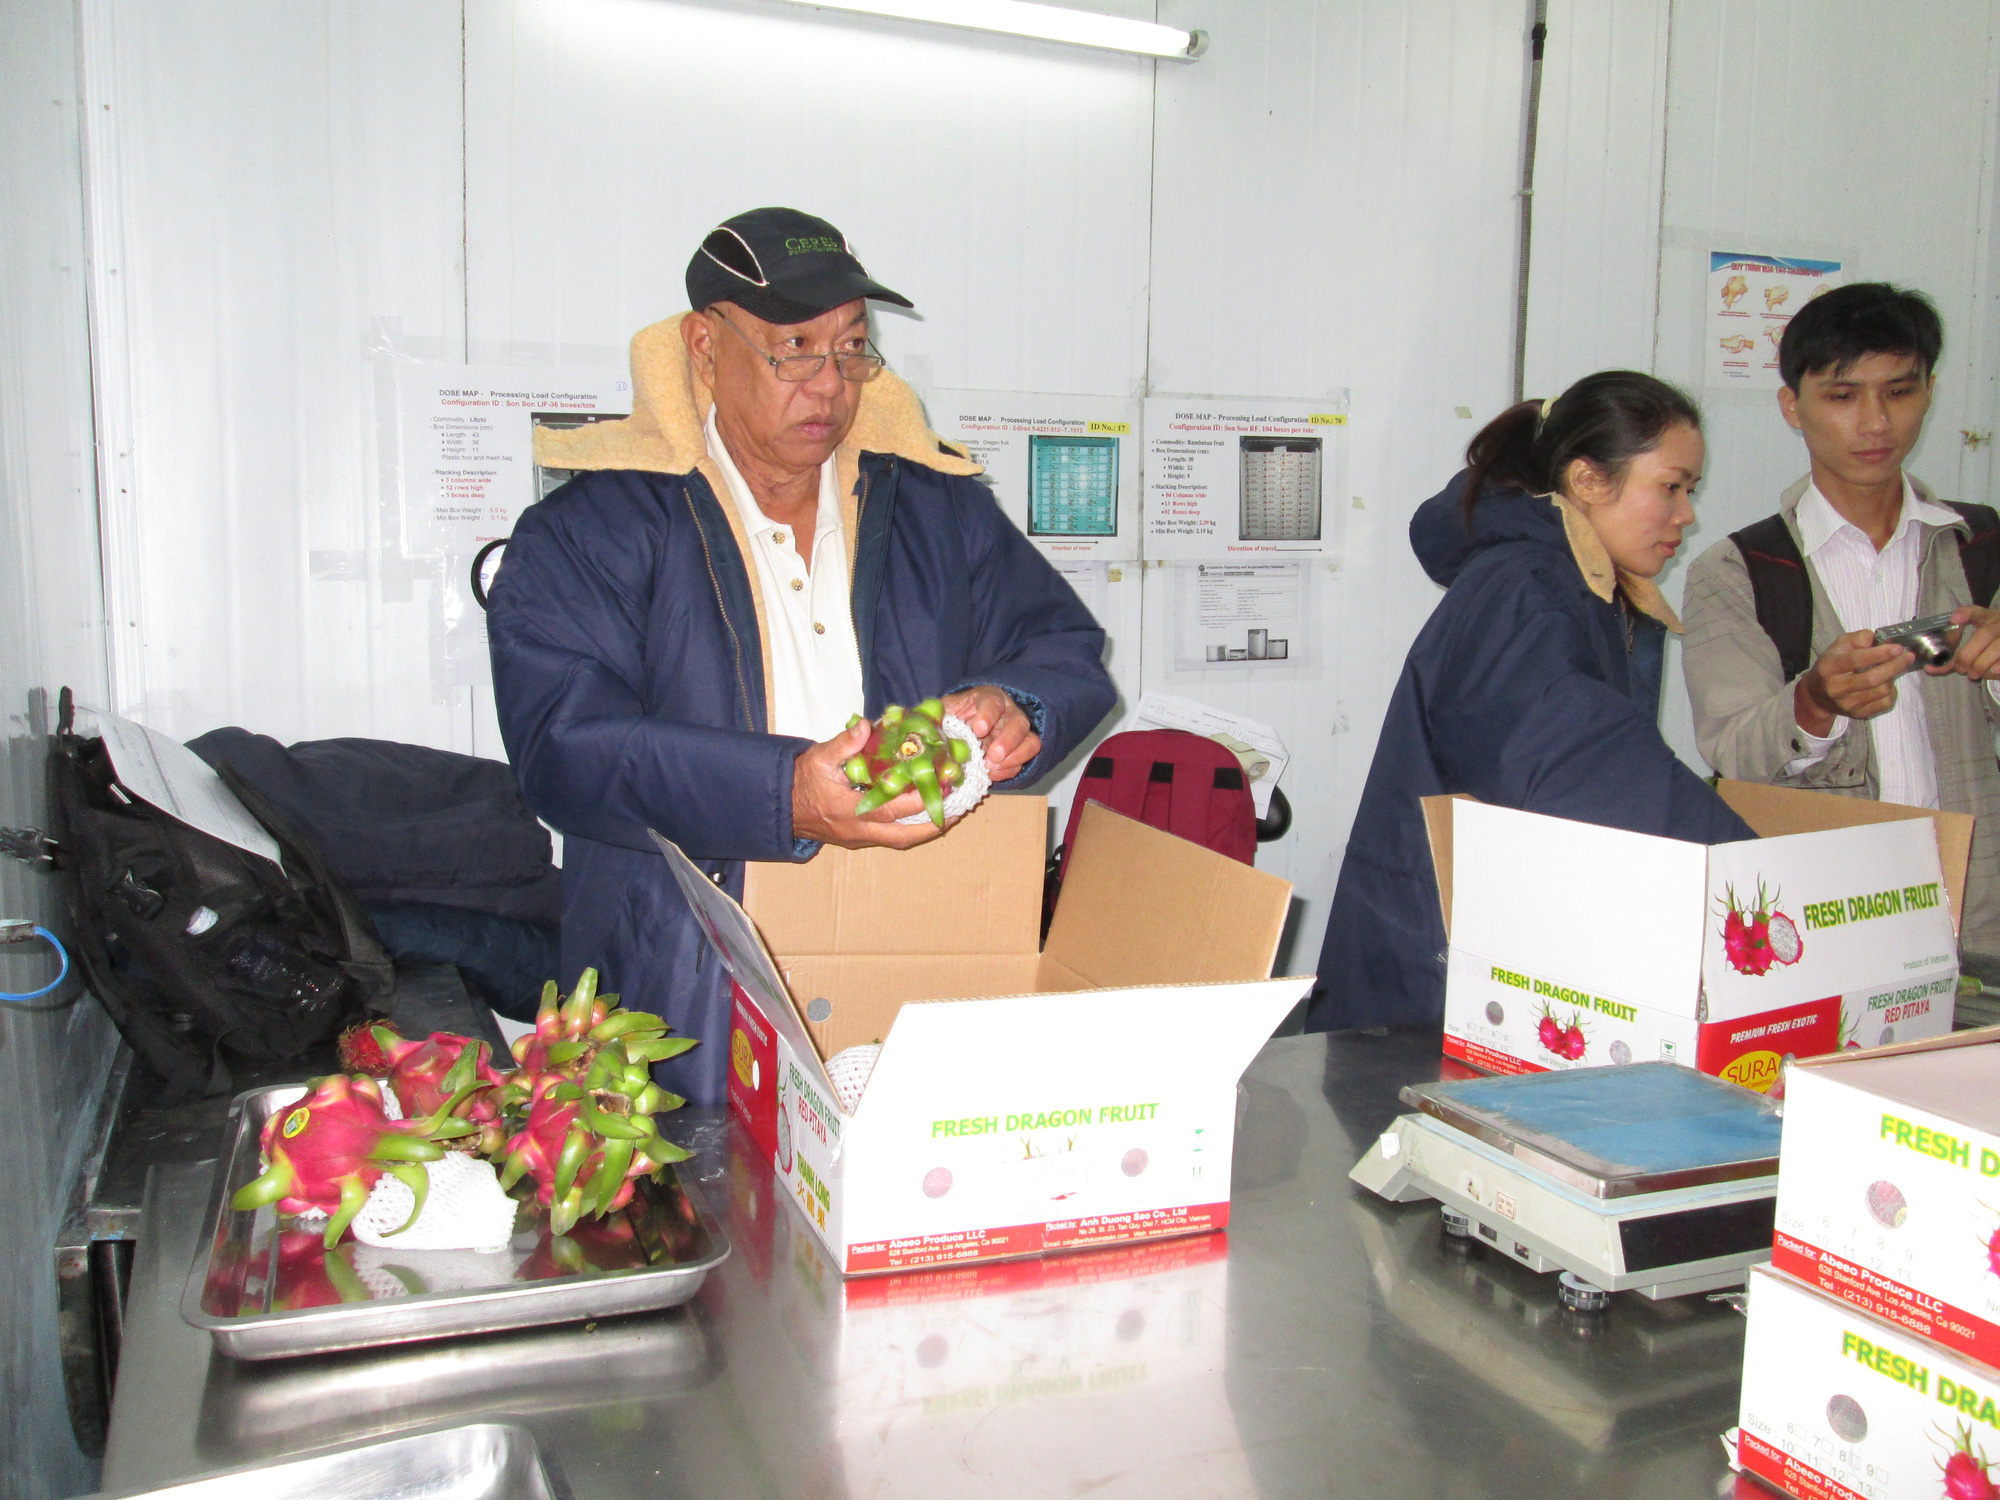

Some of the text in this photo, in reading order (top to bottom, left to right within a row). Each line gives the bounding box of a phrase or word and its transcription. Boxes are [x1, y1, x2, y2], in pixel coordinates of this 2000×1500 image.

[786, 237, 837, 249] CERES
[490, 391, 529, 399] Processing
[1001, 417, 1032, 425] Processing
[1169, 424, 1211, 432] Configuration
[1219, 415, 1250, 423] Processing
[1268, 416, 1308, 424] Configuration
[1803, 882, 1939, 930] FRESH DRAGON FRUIT
[1491, 966, 1638, 1022] FRESH DRAGON FRUIT
[1867, 977, 1953, 1011] FRESH DRAGON FRUIT
[1885, 1000, 1930, 1024] RED PITAYA
[1730, 1014, 1817, 1044] PREMIUM FRESH EXOTIC
[1467, 1043, 1521, 1066] Abeeo Produce LLC
[1728, 1057, 1777, 1084] SURA
[799, 1096, 827, 1147] RED PITAYA
[932, 1103, 1159, 1139] FRESH DRAGON FRUIT
[1880, 1113, 1970, 1169] FRESH
[1080, 1218, 1098, 1227] Anh
[1102, 1213, 1131, 1225] Duong
[1134, 1212, 1150, 1220] Sao
[1153, 1210, 1169, 1218] Co.,
[1173, 1208, 1187, 1216] Ltd
[1781, 1212, 1805, 1230] Size
[852, 1230, 985, 1254] Packed for: Abeeo Produce LLC
[902, 1237, 1008, 1256] Stanford 90021
[910, 1255, 933, 1264] (213)
[937, 1250, 978, 1260] 915-6888
[1817, 1234, 1911, 1283] 10 11 12 13
[1778, 1235, 1943, 1313] Packed for: Abeeo Produce LLC
[1818, 1277, 1931, 1335] Tel (213) 915-6888
[1819, 1263, 1832, 1276] 628
[1834, 1270, 1865, 1292] Stanford
[1885, 1293, 1899, 1305] Los
[1900, 1300, 1933, 1322] Angeles,
[1936, 1315, 1948, 1328] Ca
[1949, 1320, 1976, 1340] 90021
[1842, 1330, 1929, 1395] FRESH
[1745, 1434, 1821, 1484] Packed for: Abeeo
[1787, 1423, 1794, 1433] 6
[1814, 1436, 1821, 1448] 7
[1839, 1451, 1846, 1462] 8
[1867, 1464, 1874, 1476] 9
[1782, 1439, 1872, 1497] 10 11 12 13
[1784, 1468, 1829, 1499] 628 Stanford
[1784, 1481, 1798, 1495] Tel
